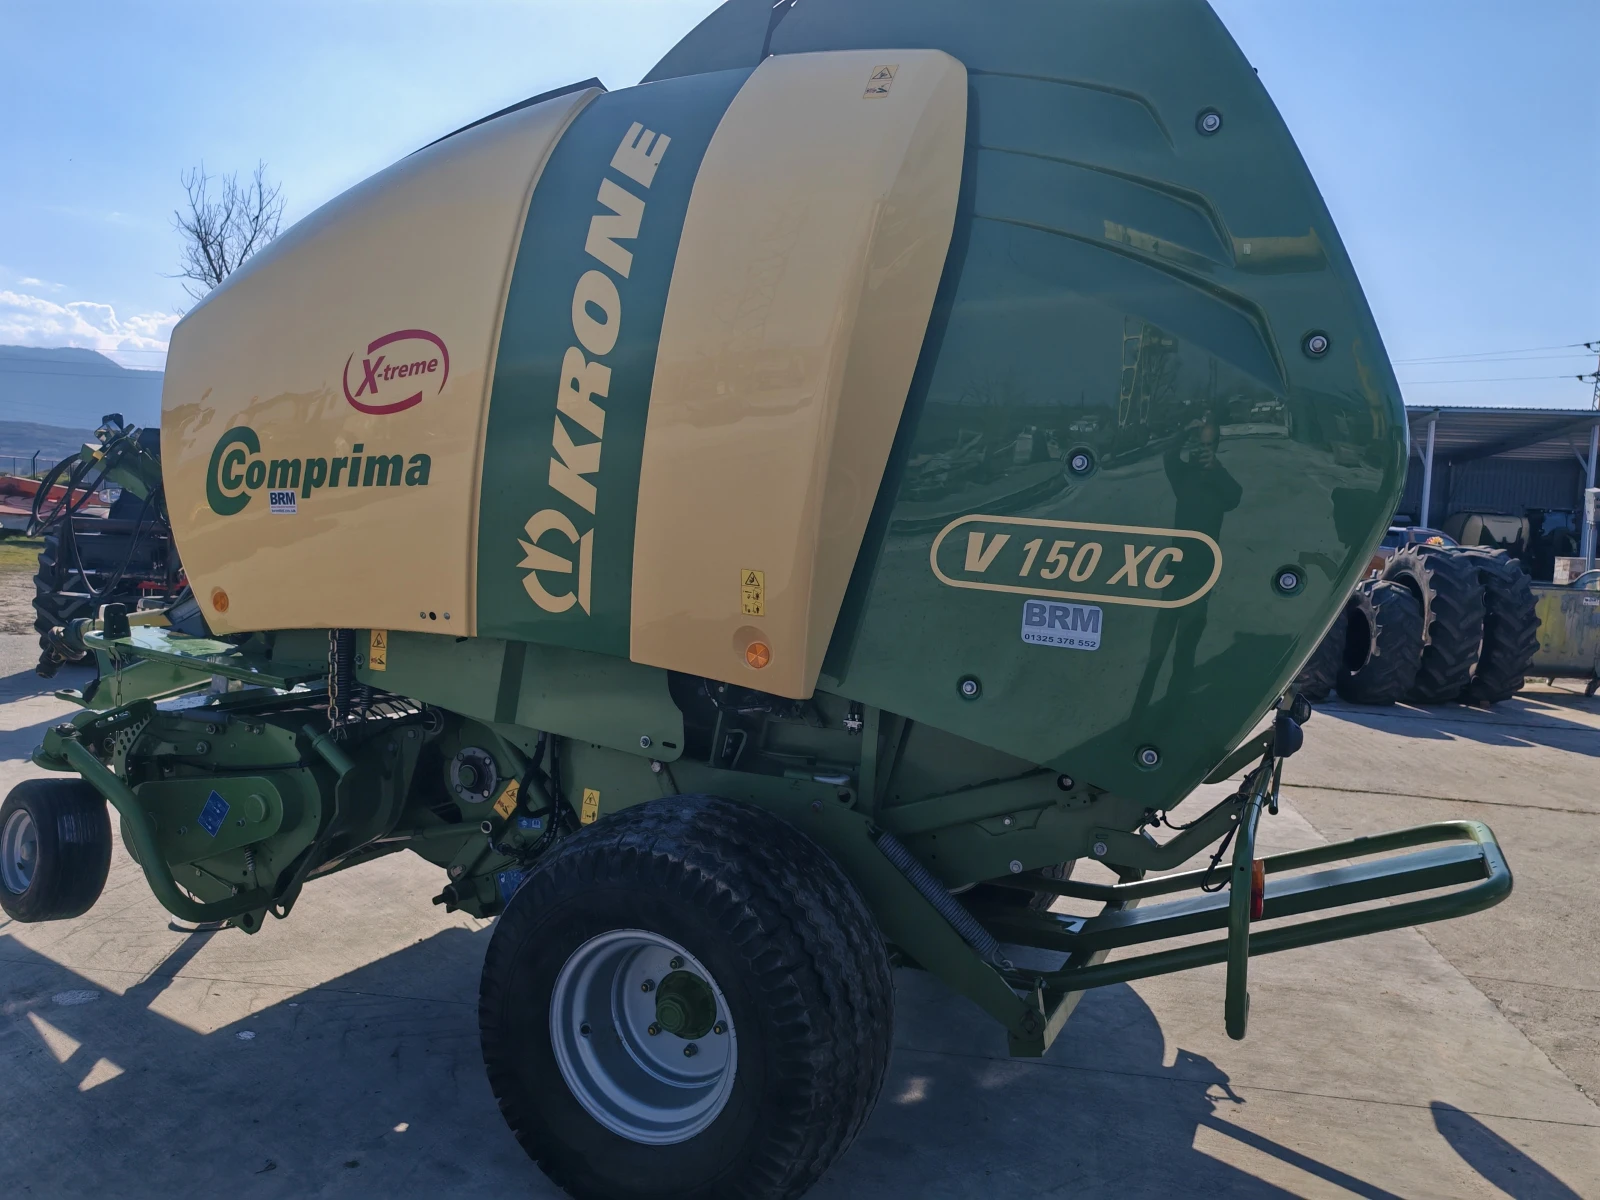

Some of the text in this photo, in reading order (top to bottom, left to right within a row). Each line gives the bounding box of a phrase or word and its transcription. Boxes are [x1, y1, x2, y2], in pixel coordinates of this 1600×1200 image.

[549, 121, 671, 515] KRONE
[355, 356, 438, 397] X-treme
[270, 492, 296, 505] BRM
[964, 531, 1184, 589] V 150 XC
[1024, 602, 1101, 634] BRM
[1024, 633, 1054, 643] 01325
[1056, 637, 1075, 646] 378
[1078, 639, 1097, 648] 552
